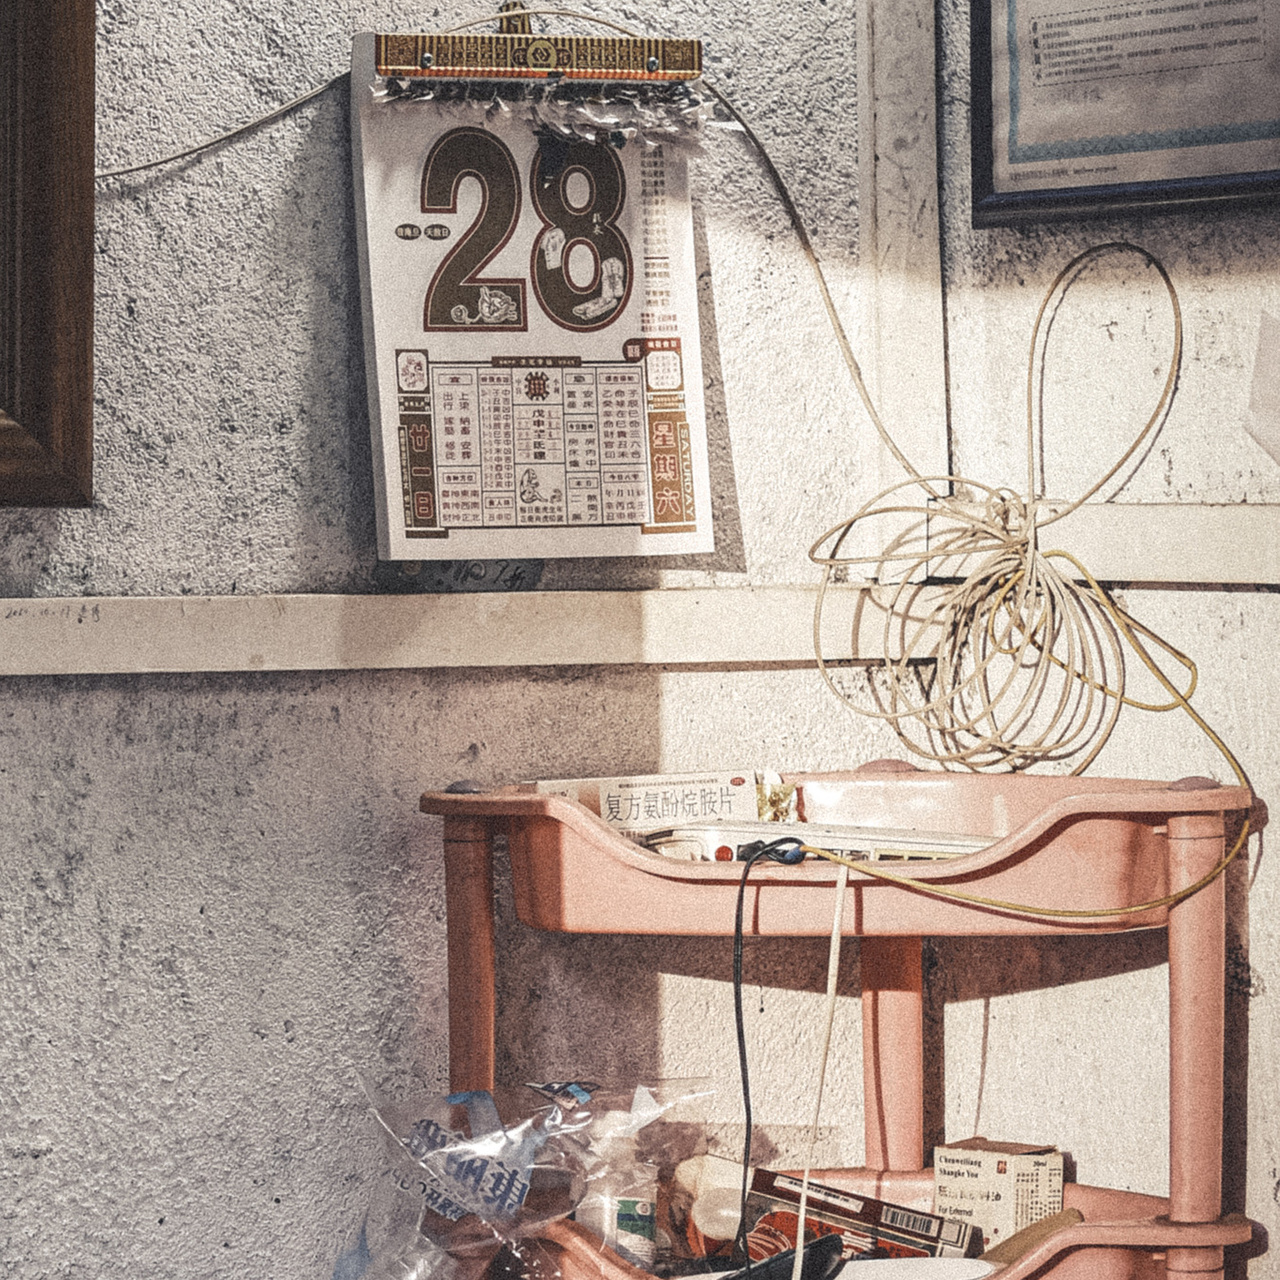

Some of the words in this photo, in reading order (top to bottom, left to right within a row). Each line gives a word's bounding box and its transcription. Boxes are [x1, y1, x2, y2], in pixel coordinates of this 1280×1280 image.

[420, 126, 634, 334] 28
[652, 420, 682, 516] 星期六
[680, 427, 696, 518] SATURDAY
[606, 787, 736, 821] 复方氨酚烷胺片
